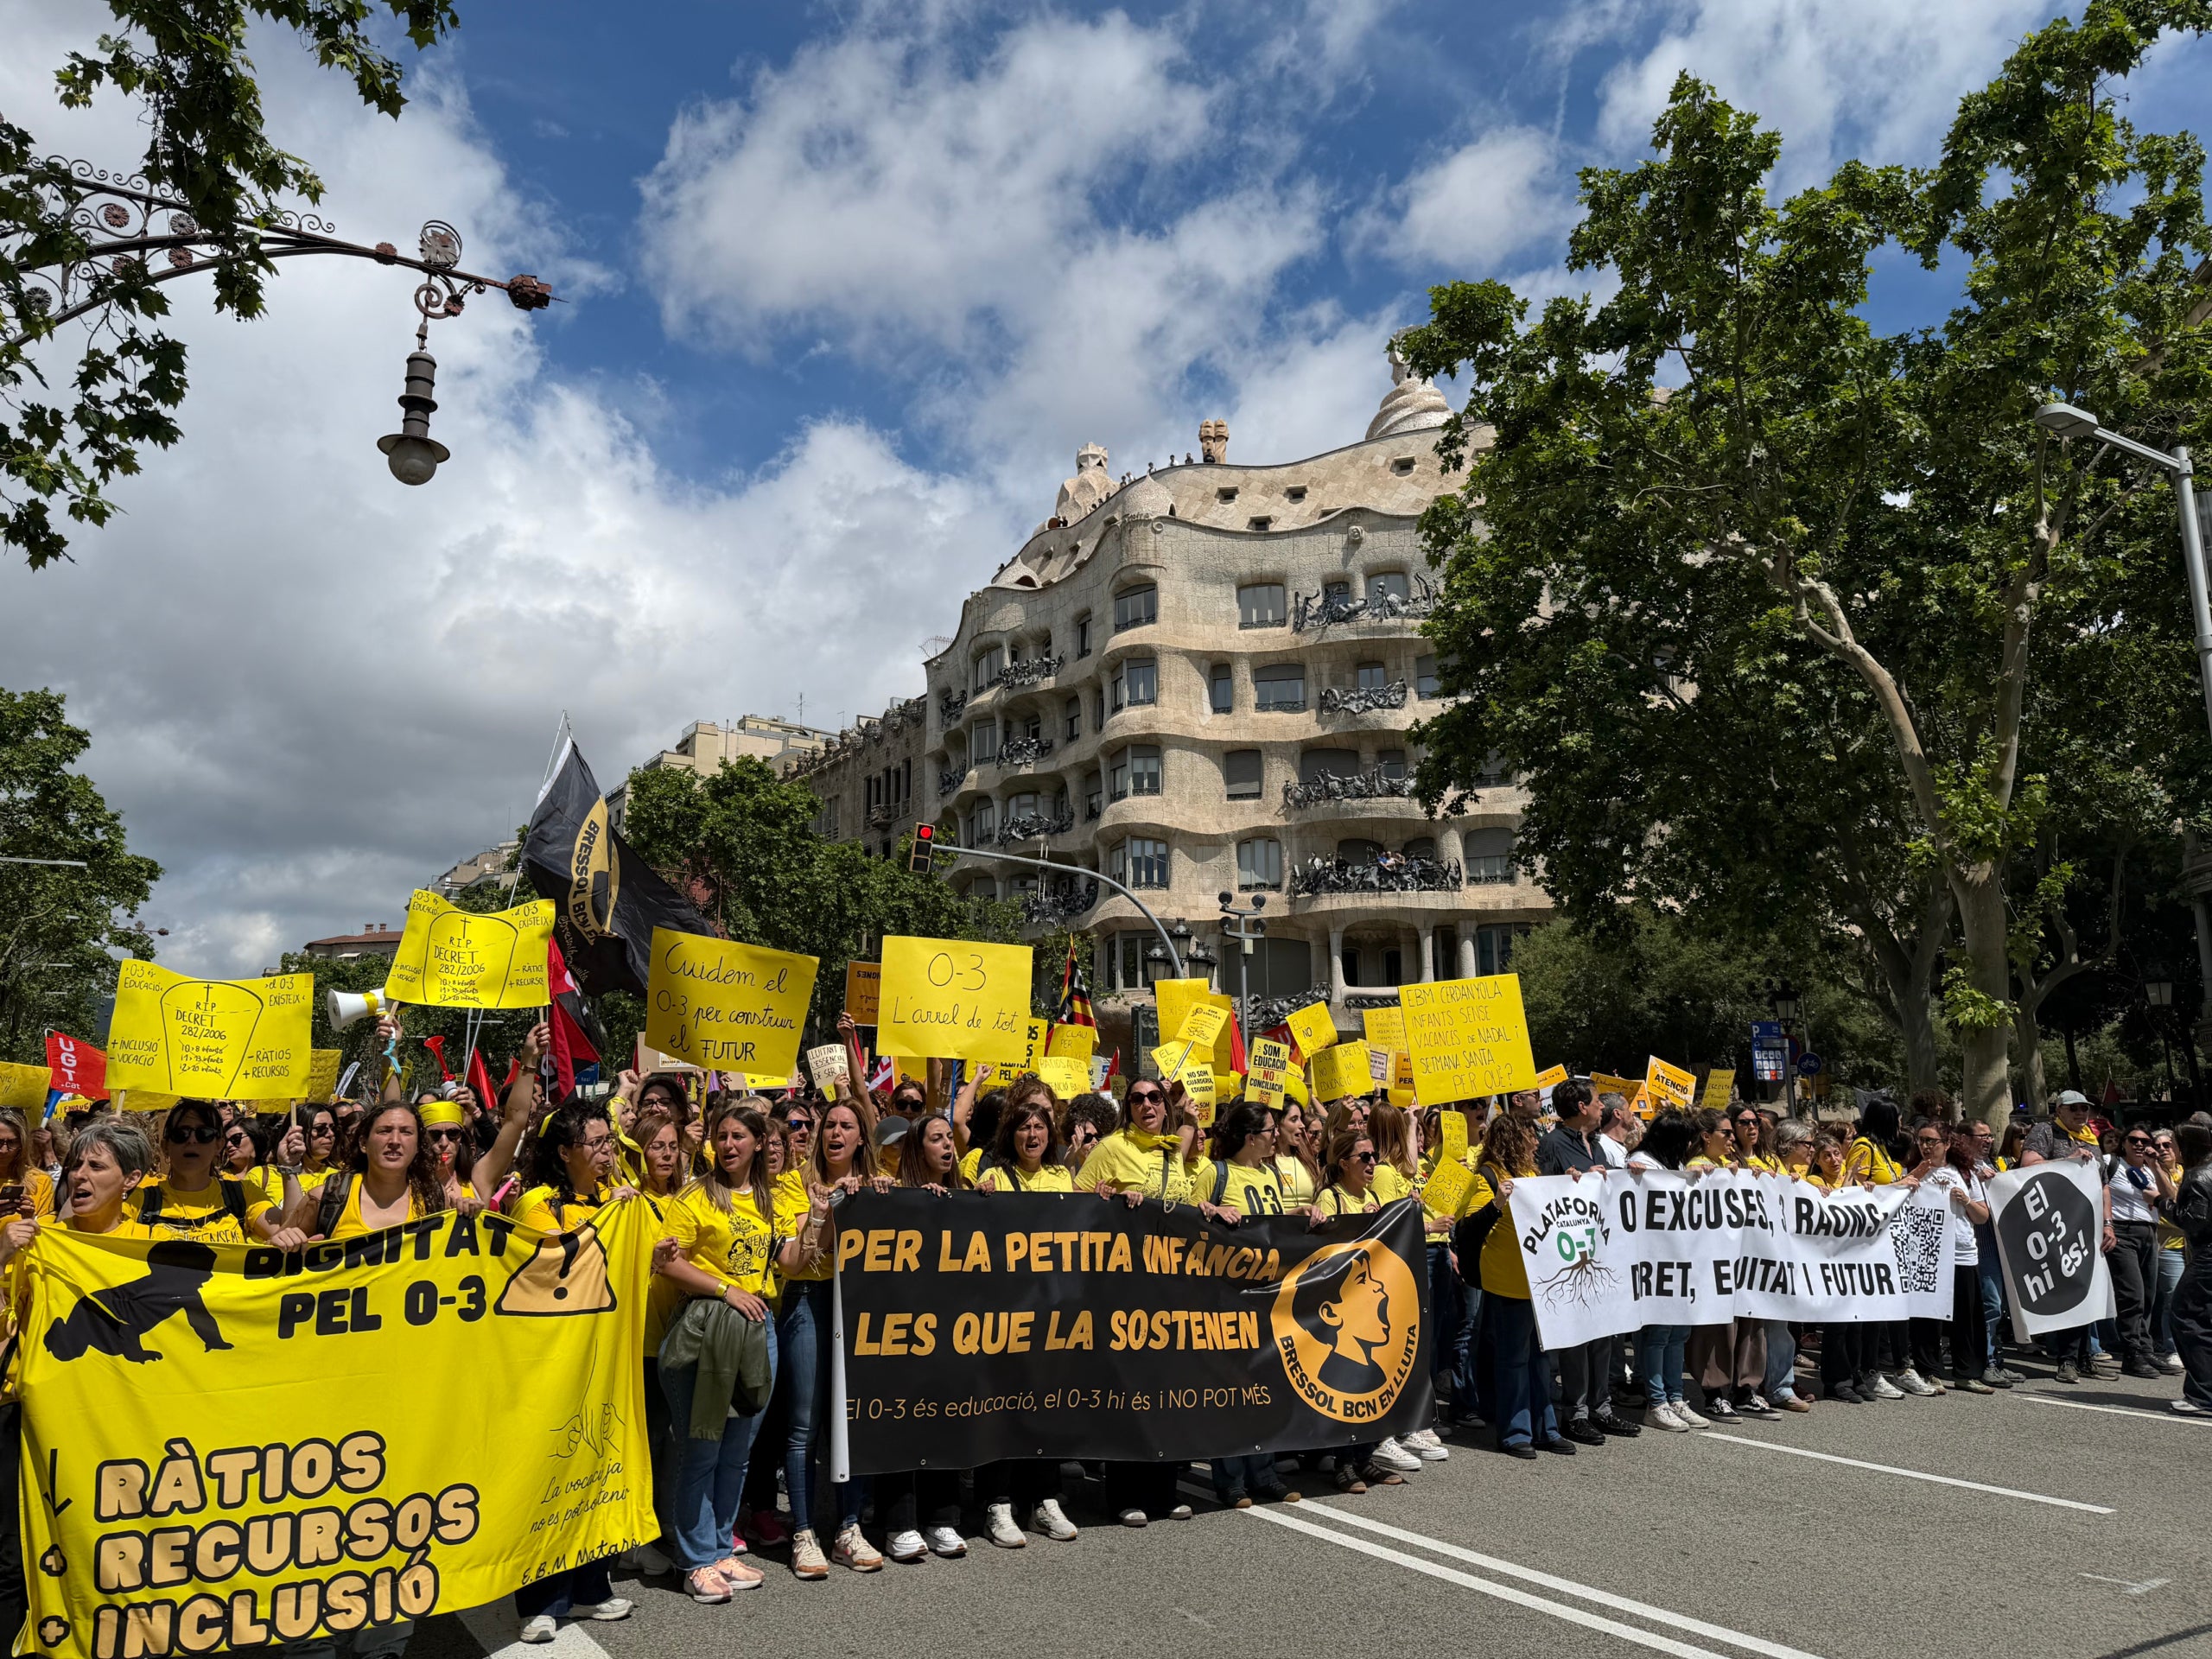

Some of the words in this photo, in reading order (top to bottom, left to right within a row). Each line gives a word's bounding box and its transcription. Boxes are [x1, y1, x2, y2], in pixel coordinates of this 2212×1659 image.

[573, 819, 601, 899] BRESSOL
[435, 945, 479, 964] DECRET
[438, 963, 485, 976] 282/2006
[664, 942, 755, 987] Cuidem
[763, 968, 788, 994] el
[928, 952, 987, 991] 0-3
[269, 994, 301, 1007] EXISTEIX
[656, 990, 688, 1016] 0-3
[692, 1006, 724, 1030] per
[728, 1003, 797, 1030] construir
[1406, 988, 1434, 1007] EBM
[1440, 981, 1503, 1004] CERDANYOLA
[175, 1009, 217, 1028] DECRET
[181, 1025, 227, 1039] 282/2006
[967, 1005, 982, 1028] de
[992, 1008, 1019, 1033] tot
[1303, 1027, 1313, 1039] NO
[1411, 1010, 1454, 1029] INFANTS
[1459, 1005, 1491, 1024] SENSE
[1752, 1025, 1759, 1038] P
[669, 1024, 691, 1052] el
[700, 1039, 756, 1062] FUTUR
[1262, 1044, 1281, 1058] SOM
[1340, 1044, 1362, 1058] DRETS
[1414, 1029, 1461, 1049] VACANCES
[1478, 1026, 1511, 1044] NADAL
[59, 1038, 77, 1081] UGT
[256, 1047, 292, 1063] RÀTIOS
[1254, 1055, 1287, 1071] EDUCACIÓ
[1420, 1053, 1460, 1074] SETMANA
[1462, 1048, 1495, 1069] SANTA
[61, 1081, 81, 1090] .cat
[251, 1065, 290, 1079] RECURSOS
[999, 1070, 1013, 1081] PEL
[1249, 1077, 1283, 1093] CONCILIACIÓ
[1262, 1070, 1274, 1081] NO
[1452, 1072, 1478, 1096] PER
[1655, 1074, 1688, 1095] ATENCIÓ
[1243, 1185, 1284, 1215] 0-3
[1645, 1188, 1774, 1237] EXCUSES,
[1778, 1194, 1788, 1234] 3
[2024, 1180, 2050, 1222] El
[1522, 1197, 1610, 1255] PLATAFORMA
[1556, 1217, 1591, 1229] CATALUNYA
[2026, 1211, 2067, 1261] 0-3
[244, 1213, 517, 1280] DIGNITAT
[839, 1229, 924, 1273] PER
[938, 1230, 991, 1273] LA
[1006, 1230, 1133, 1274] PETITA
[1141, 1230, 1281, 1282] INFÀNCIA
[1557, 1228, 1596, 1262] 0-3
[1802, 1262, 1815, 1296] I
[1819, 1262, 1896, 1296] FUTUR
[2023, 1262, 2055, 1303] hi
[2059, 1230, 2088, 1278] és!
[277, 1286, 382, 1339] PEL
[404, 1274, 487, 1326] 0-3
[854, 1311, 938, 1357] LES
[952, 1310, 1036, 1356] QUE
[1044, 1309, 1094, 1351] LA
[1109, 1308, 1260, 1351] SOSTENEN
[1280, 1335, 1338, 1414] BRESSOL
[1343, 1400, 1378, 1419] BCN
[1379, 1384, 1395, 1411] EN
[1393, 1323, 1417, 1389] LLUITA
[868, 1398, 906, 1421] 0-3
[913, 1398, 938, 1418] és
[944, 1390, 1038, 1418] educació,
[1044, 1388, 1062, 1408] el
[1067, 1389, 1102, 1409] 0-3
[1107, 1389, 1126, 1410] hi
[1131, 1390, 1151, 1411] és
[1159, 1390, 1165, 1409] i
[1169, 1389, 1198, 1409] NO
[1203, 1388, 1237, 1408] POT
[1242, 1382, 1271, 1407] MÉS
[94, 1429, 387, 1523] RÀTIOS
[541, 1476, 562, 1504] La
[601, 1459, 623, 1486] ja
[530, 1519, 545, 1535] no
[548, 1511, 559, 1526] es
[560, 1499, 584, 1532] pot
[94, 1482, 480, 1595] RECURSOS
[575, 1533, 641, 1567] Mataró
[92, 1548, 441, 1659] INCLUSIÓ
